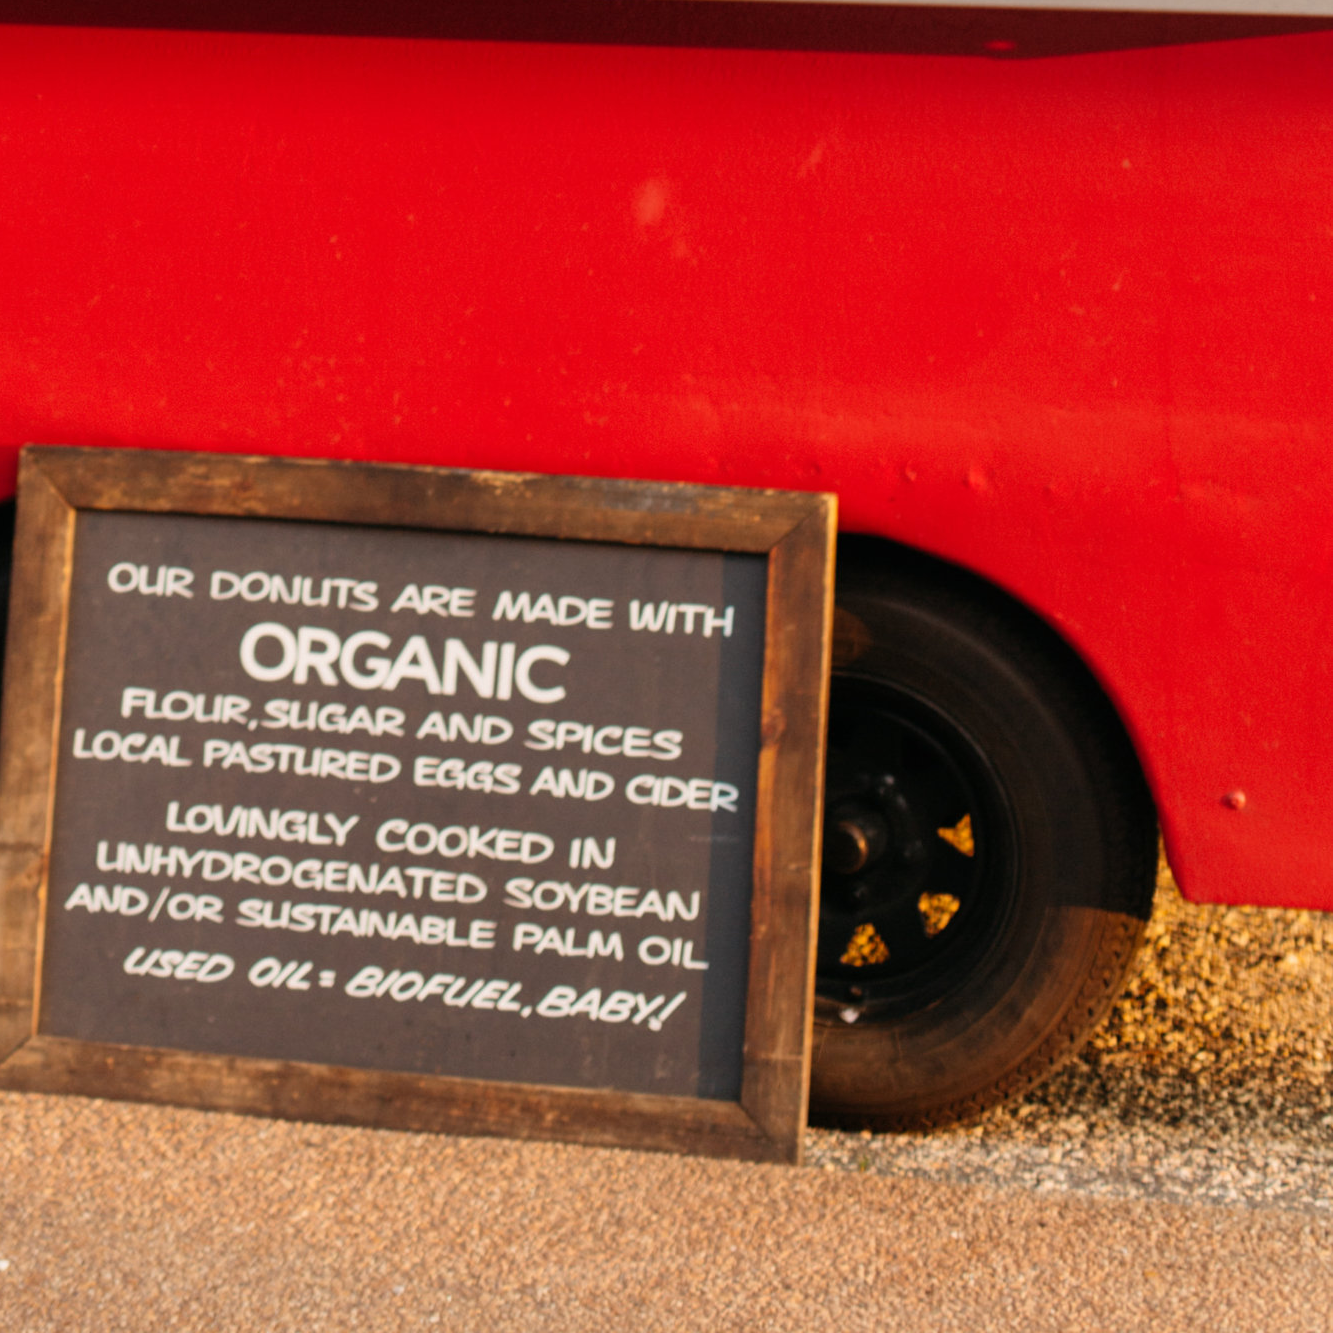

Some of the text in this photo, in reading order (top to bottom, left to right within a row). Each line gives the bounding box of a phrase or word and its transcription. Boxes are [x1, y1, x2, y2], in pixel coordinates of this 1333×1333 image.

[107, 562, 734, 638] OUR DONUTS ARE MADE WITH
[239, 622, 571, 704] ORGANIC
[72, 727, 740, 813] LOCAL PASTURED EGGS AND CIDER
[261, 699, 405, 737] SUGAR
[417, 711, 514, 745] AND
[524, 719, 683, 760] SPICES
[165, 800, 617, 869] LOVINGLY COOKED IN
[96, 840, 701, 921] UNHYDROGENATED SOYBEAN
[63, 882, 710, 971] AND/OR SUSTAINABLE PALM OIL
[123, 946, 236, 983] USED
[247, 956, 314, 990] OIL
[535, 985, 688, 1032] BABY!
